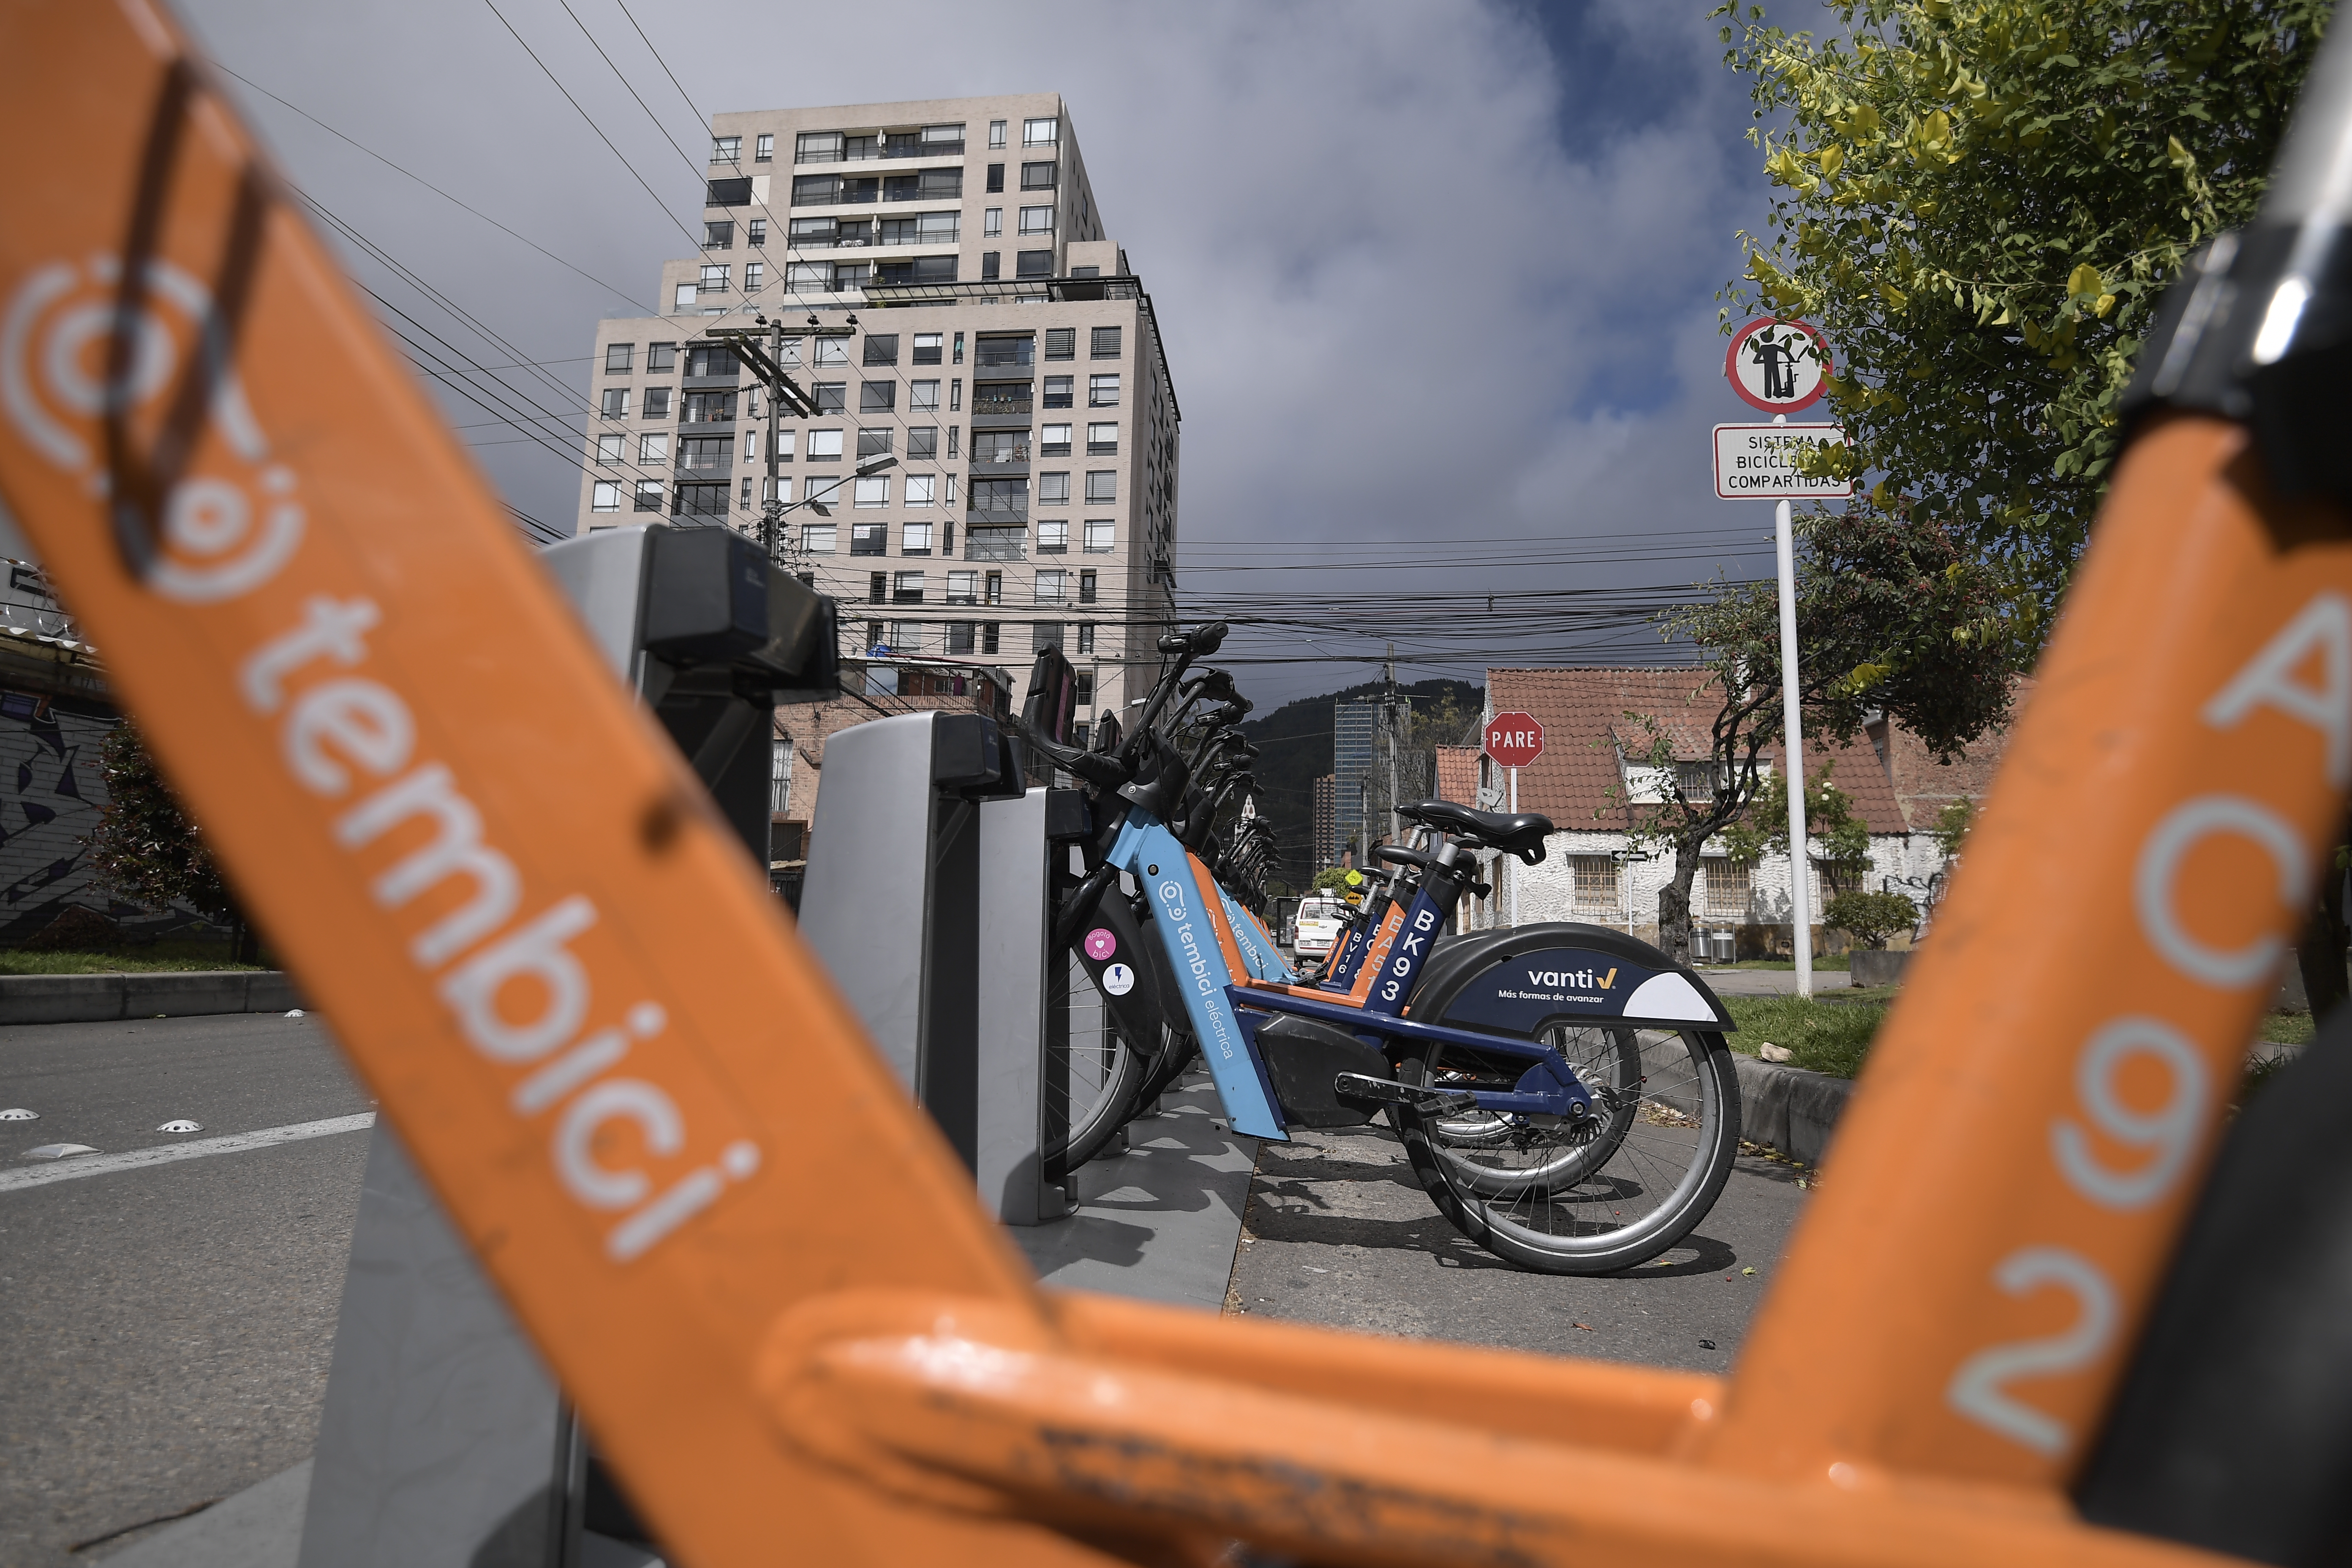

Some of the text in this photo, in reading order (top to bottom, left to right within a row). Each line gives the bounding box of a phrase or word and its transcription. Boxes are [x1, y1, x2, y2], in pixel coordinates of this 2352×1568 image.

[1492, 731, 1535, 748] PARE
[237, 591, 762, 1263] tembici
[1088, 931, 1111, 940] Bogotá
[1092, 949, 1109, 958] bici
[1232, 923, 1269, 970] tembici
[1338, 932, 1362, 974] BV16
[1381, 909, 1435, 1001] BK93
[1178, 922, 1217, 997] tembici
[1205, 999, 1233, 1060] eléctrica
[1528, 969, 1592, 988] vanti
[1498, 990, 1604, 1003] Más formas de avanzar
